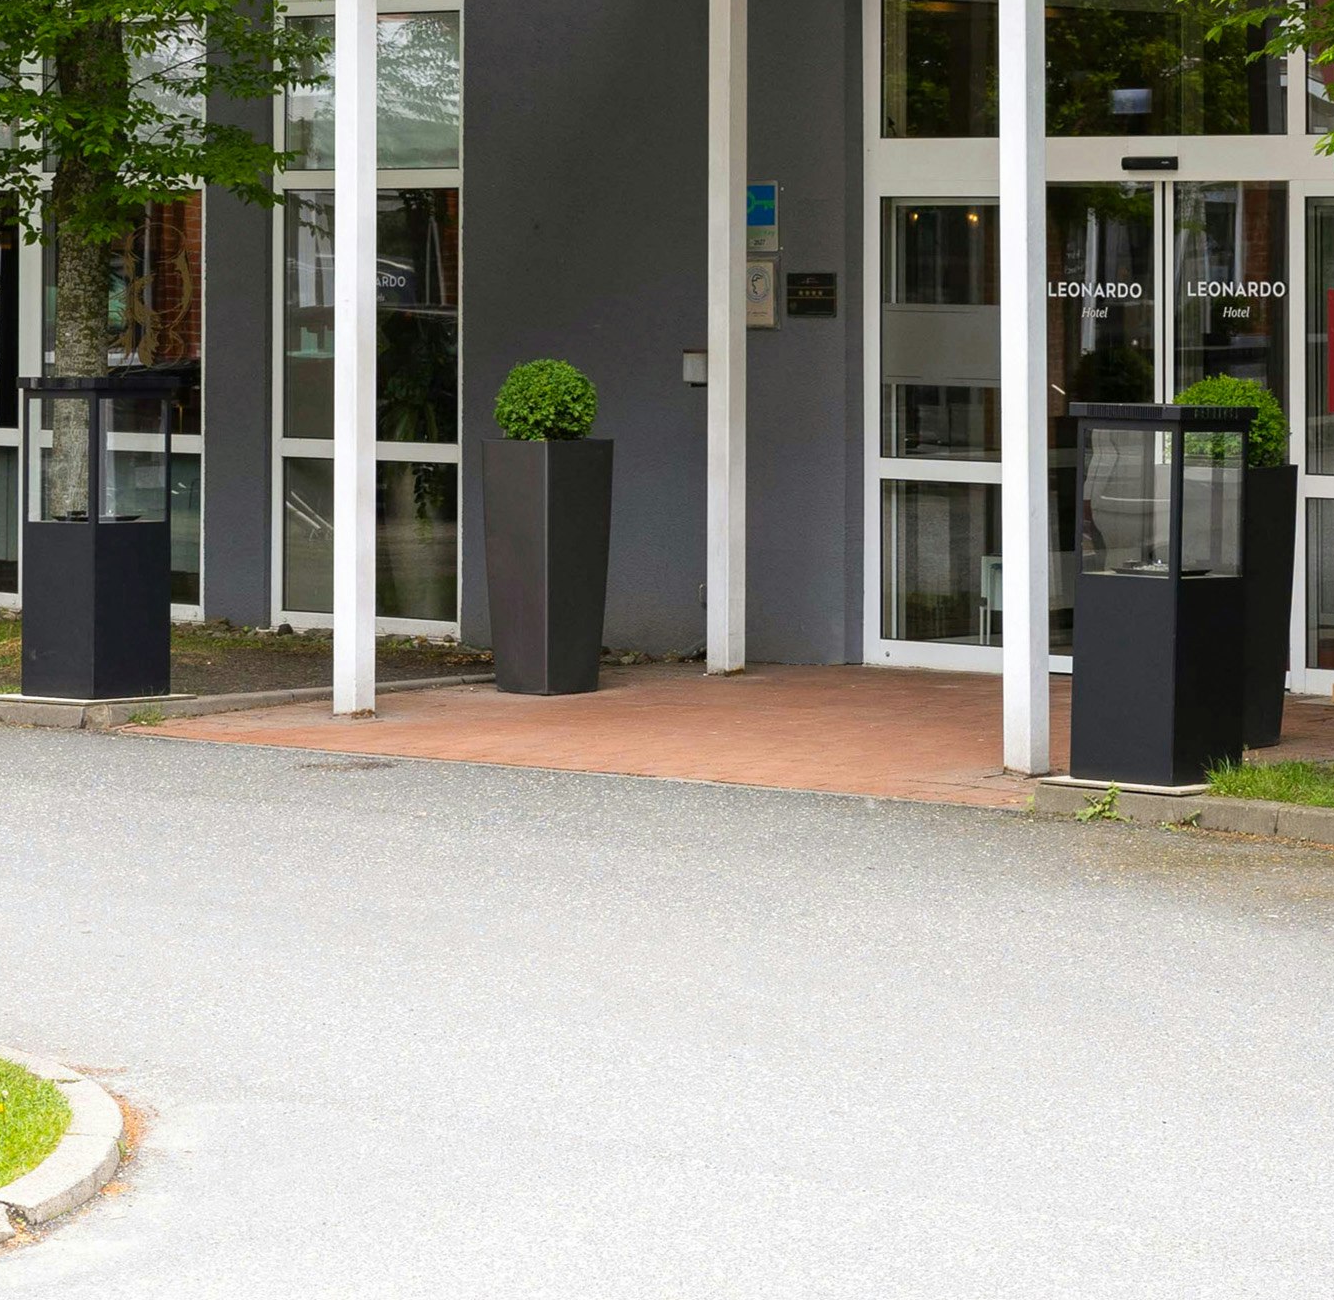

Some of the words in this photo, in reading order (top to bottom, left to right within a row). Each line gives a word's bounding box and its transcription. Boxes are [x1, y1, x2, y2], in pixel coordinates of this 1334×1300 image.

[1048, 282, 1142, 298] LEONARDO
[1187, 281, 1285, 297] LEONARDO
[1082, 307, 1108, 318] Hotel
[1223, 306, 1250, 318] Hotel
